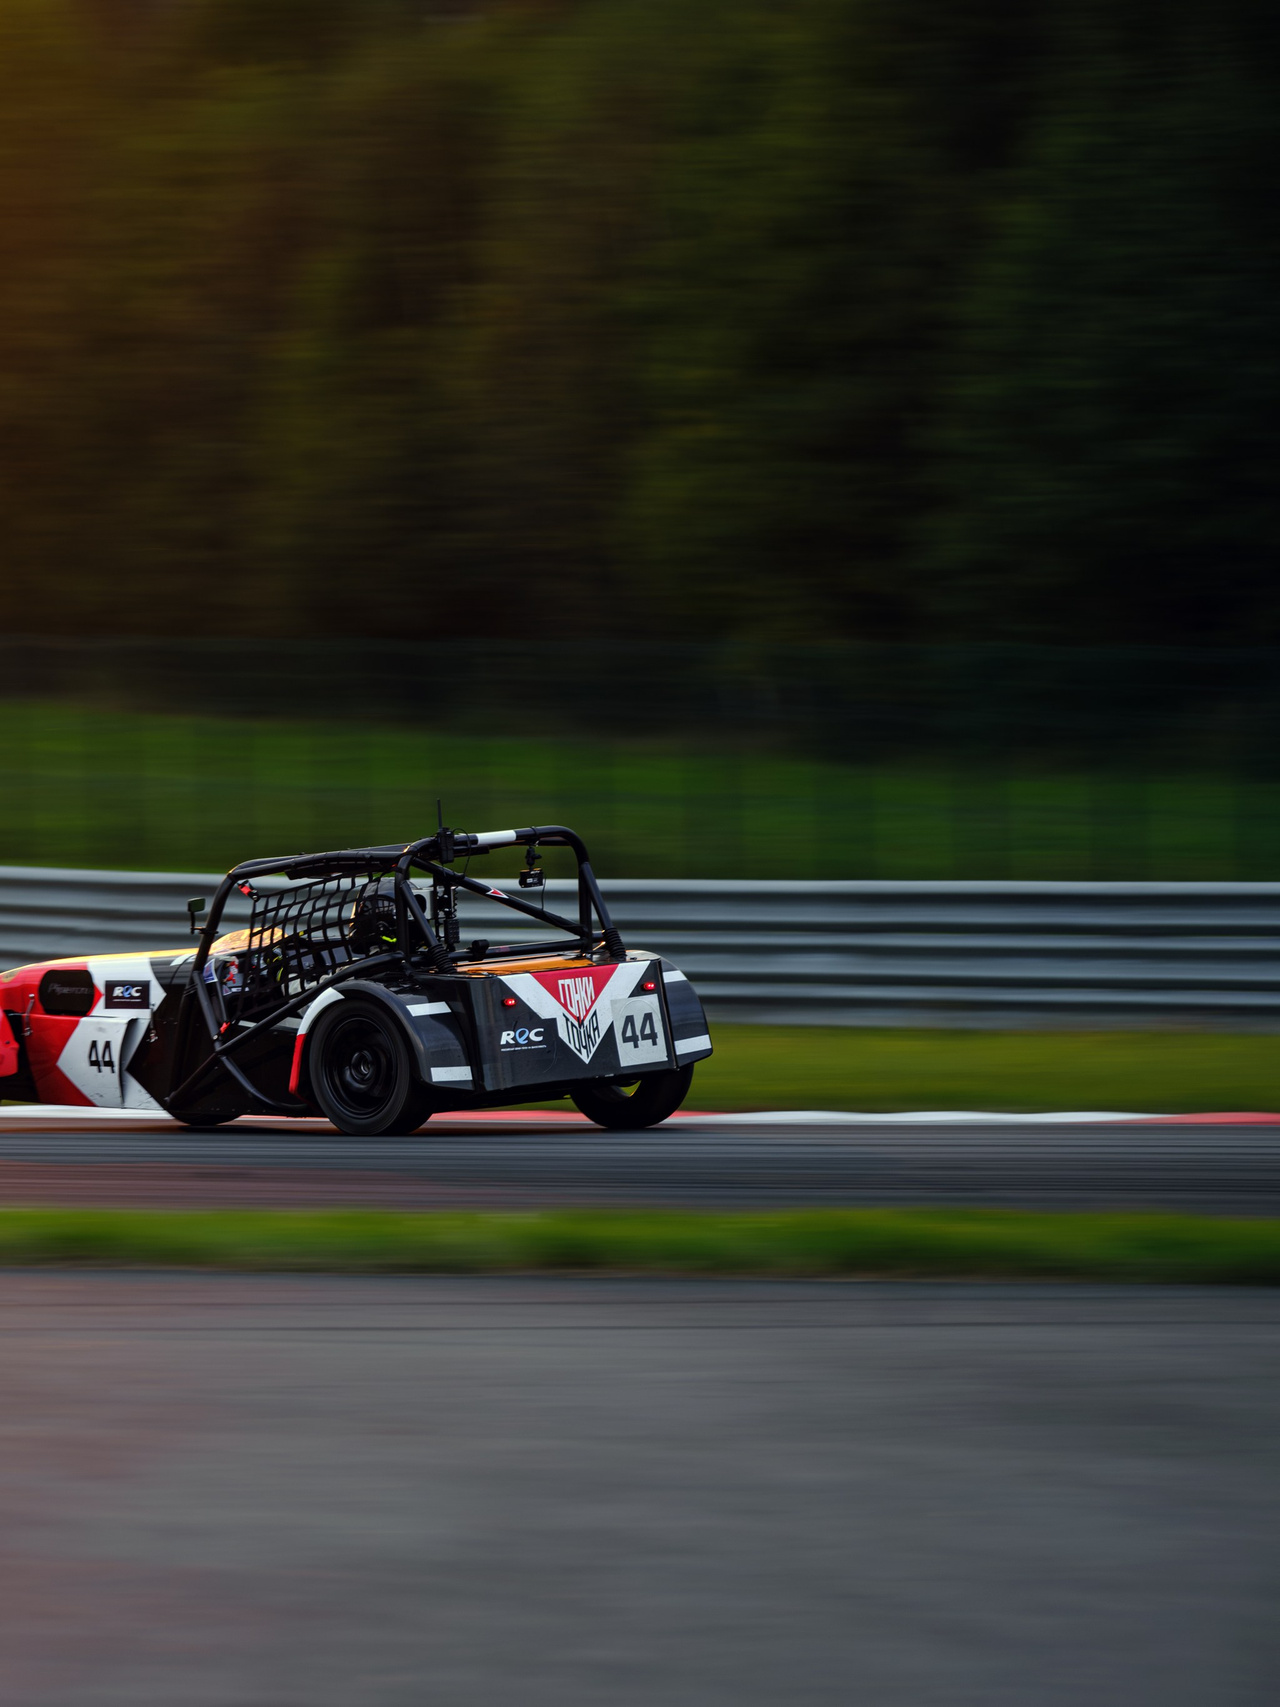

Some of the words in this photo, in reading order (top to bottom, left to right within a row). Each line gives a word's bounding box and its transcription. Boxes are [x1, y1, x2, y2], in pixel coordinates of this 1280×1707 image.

[558, 976, 596, 1020] ГОНКИ
[562, 1009, 601, 1059] ТОЧКА
[621, 1012, 658, 1049] 44
[88, 1040, 115, 1073] 44
